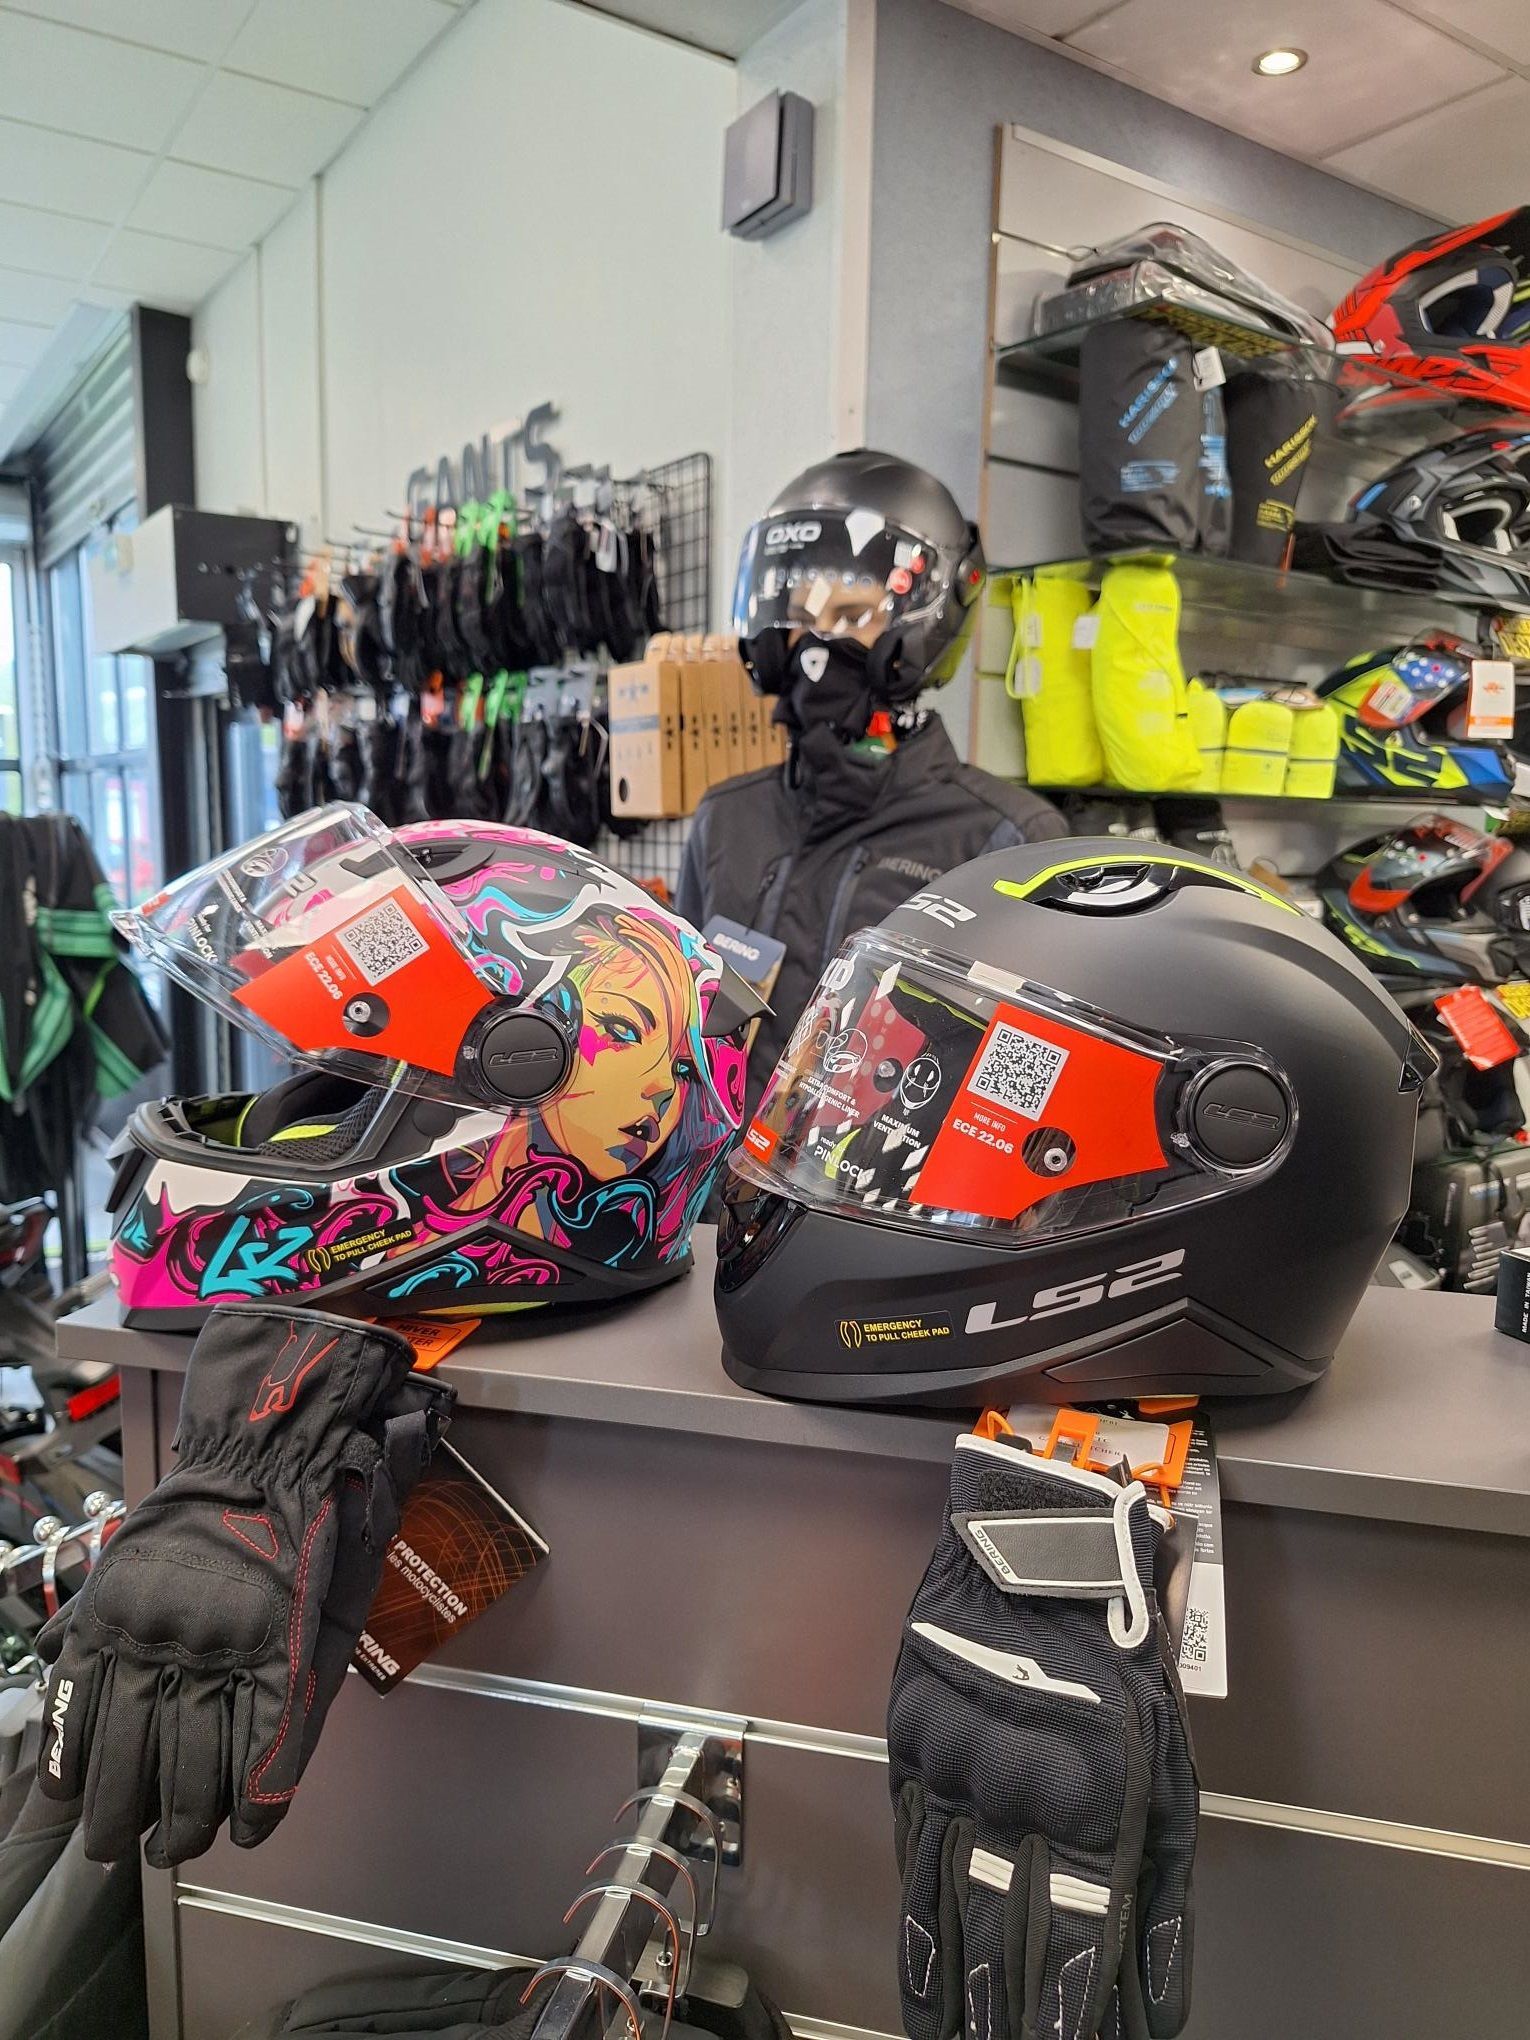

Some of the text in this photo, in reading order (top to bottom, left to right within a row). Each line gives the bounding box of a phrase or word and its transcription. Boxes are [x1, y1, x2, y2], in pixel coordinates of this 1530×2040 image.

[766, 520, 823, 545] OXO
[712, 932, 761, 961] BERING
[304, 951, 343, 1000] ECE 22.06
[822, 1084, 851, 1103] COMFORT
[841, 1103, 860, 1118] LINER
[973, 1111, 1006, 1132] MORE INFO
[820, 1136, 836, 1149] ready
[873, 1120, 922, 1149] VENTTION
[952, 1118, 1014, 1154] ECE 22.06
[330, 1229, 386, 1254] EMERGENCY
[333, 1230, 412, 1262] TO PULL CHEEK PAD
[964, 1248, 1186, 1335] LS2
[1523, 1301, 1530, 1310] IN
[863, 1319, 922, 1333] EMERGENCY
[866, 1326, 950, 1342] TO PULL CHEEK PAD
[1521, 1311, 1529, 1334] MADE
[975, 1529, 1011, 1575] BERING
[387, 1550, 457, 1624] les motocyclistes
[393, 1539, 468, 1617] PROTECTION
[358, 1629, 401, 1677] RING
